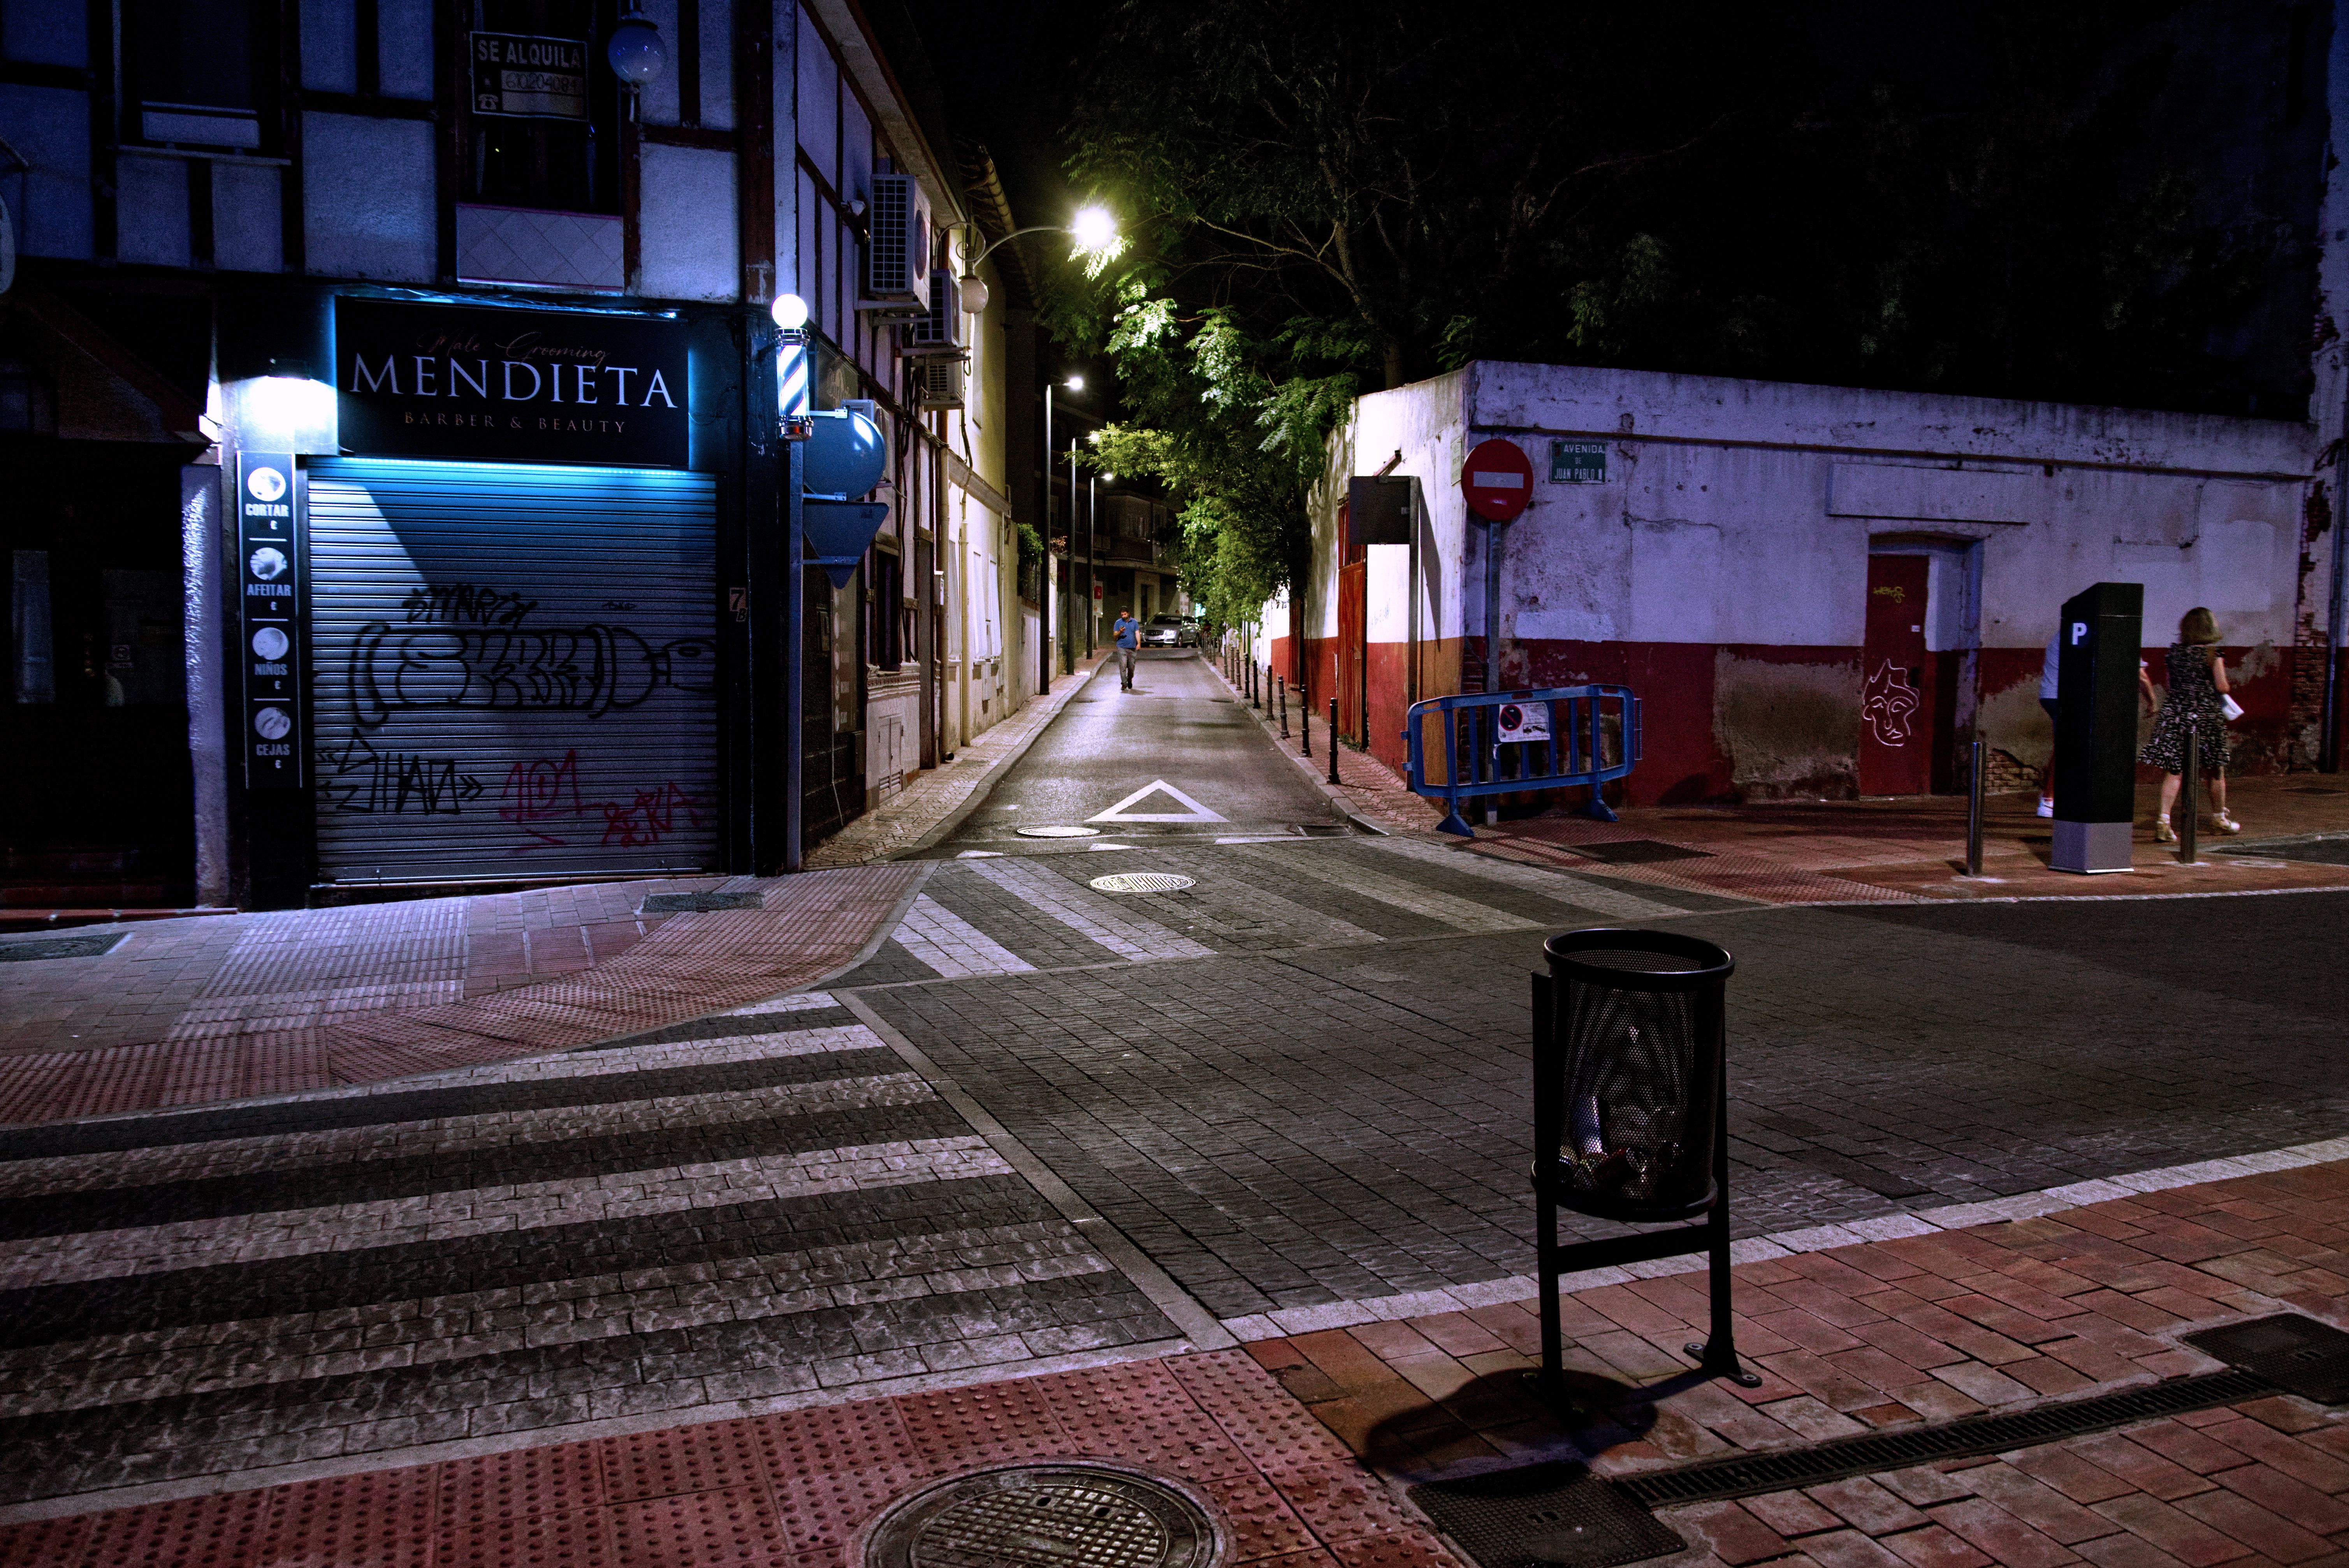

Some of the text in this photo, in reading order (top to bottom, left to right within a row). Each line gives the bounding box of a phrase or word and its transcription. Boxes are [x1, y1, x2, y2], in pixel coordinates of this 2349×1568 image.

[477, 39, 581, 69] SE ALQUILA
[416, 327, 611, 373] Male Grooming
[349, 352, 678, 409] MENDIETA
[404, 412, 626, 434] BARBER & BEAUTY
[1563, 444, 1604, 453] AVENIDA
[1554, 468, 1571, 479] JUAN
[1575, 468, 1595, 480] PABLO
[245, 503, 289, 517] CORTAR
[246, 584, 292, 597] AFEITAR
[2072, 622, 2087, 645] P
[254, 661, 288, 675] NIÑOS
[256, 743, 291, 756] CEJAS
